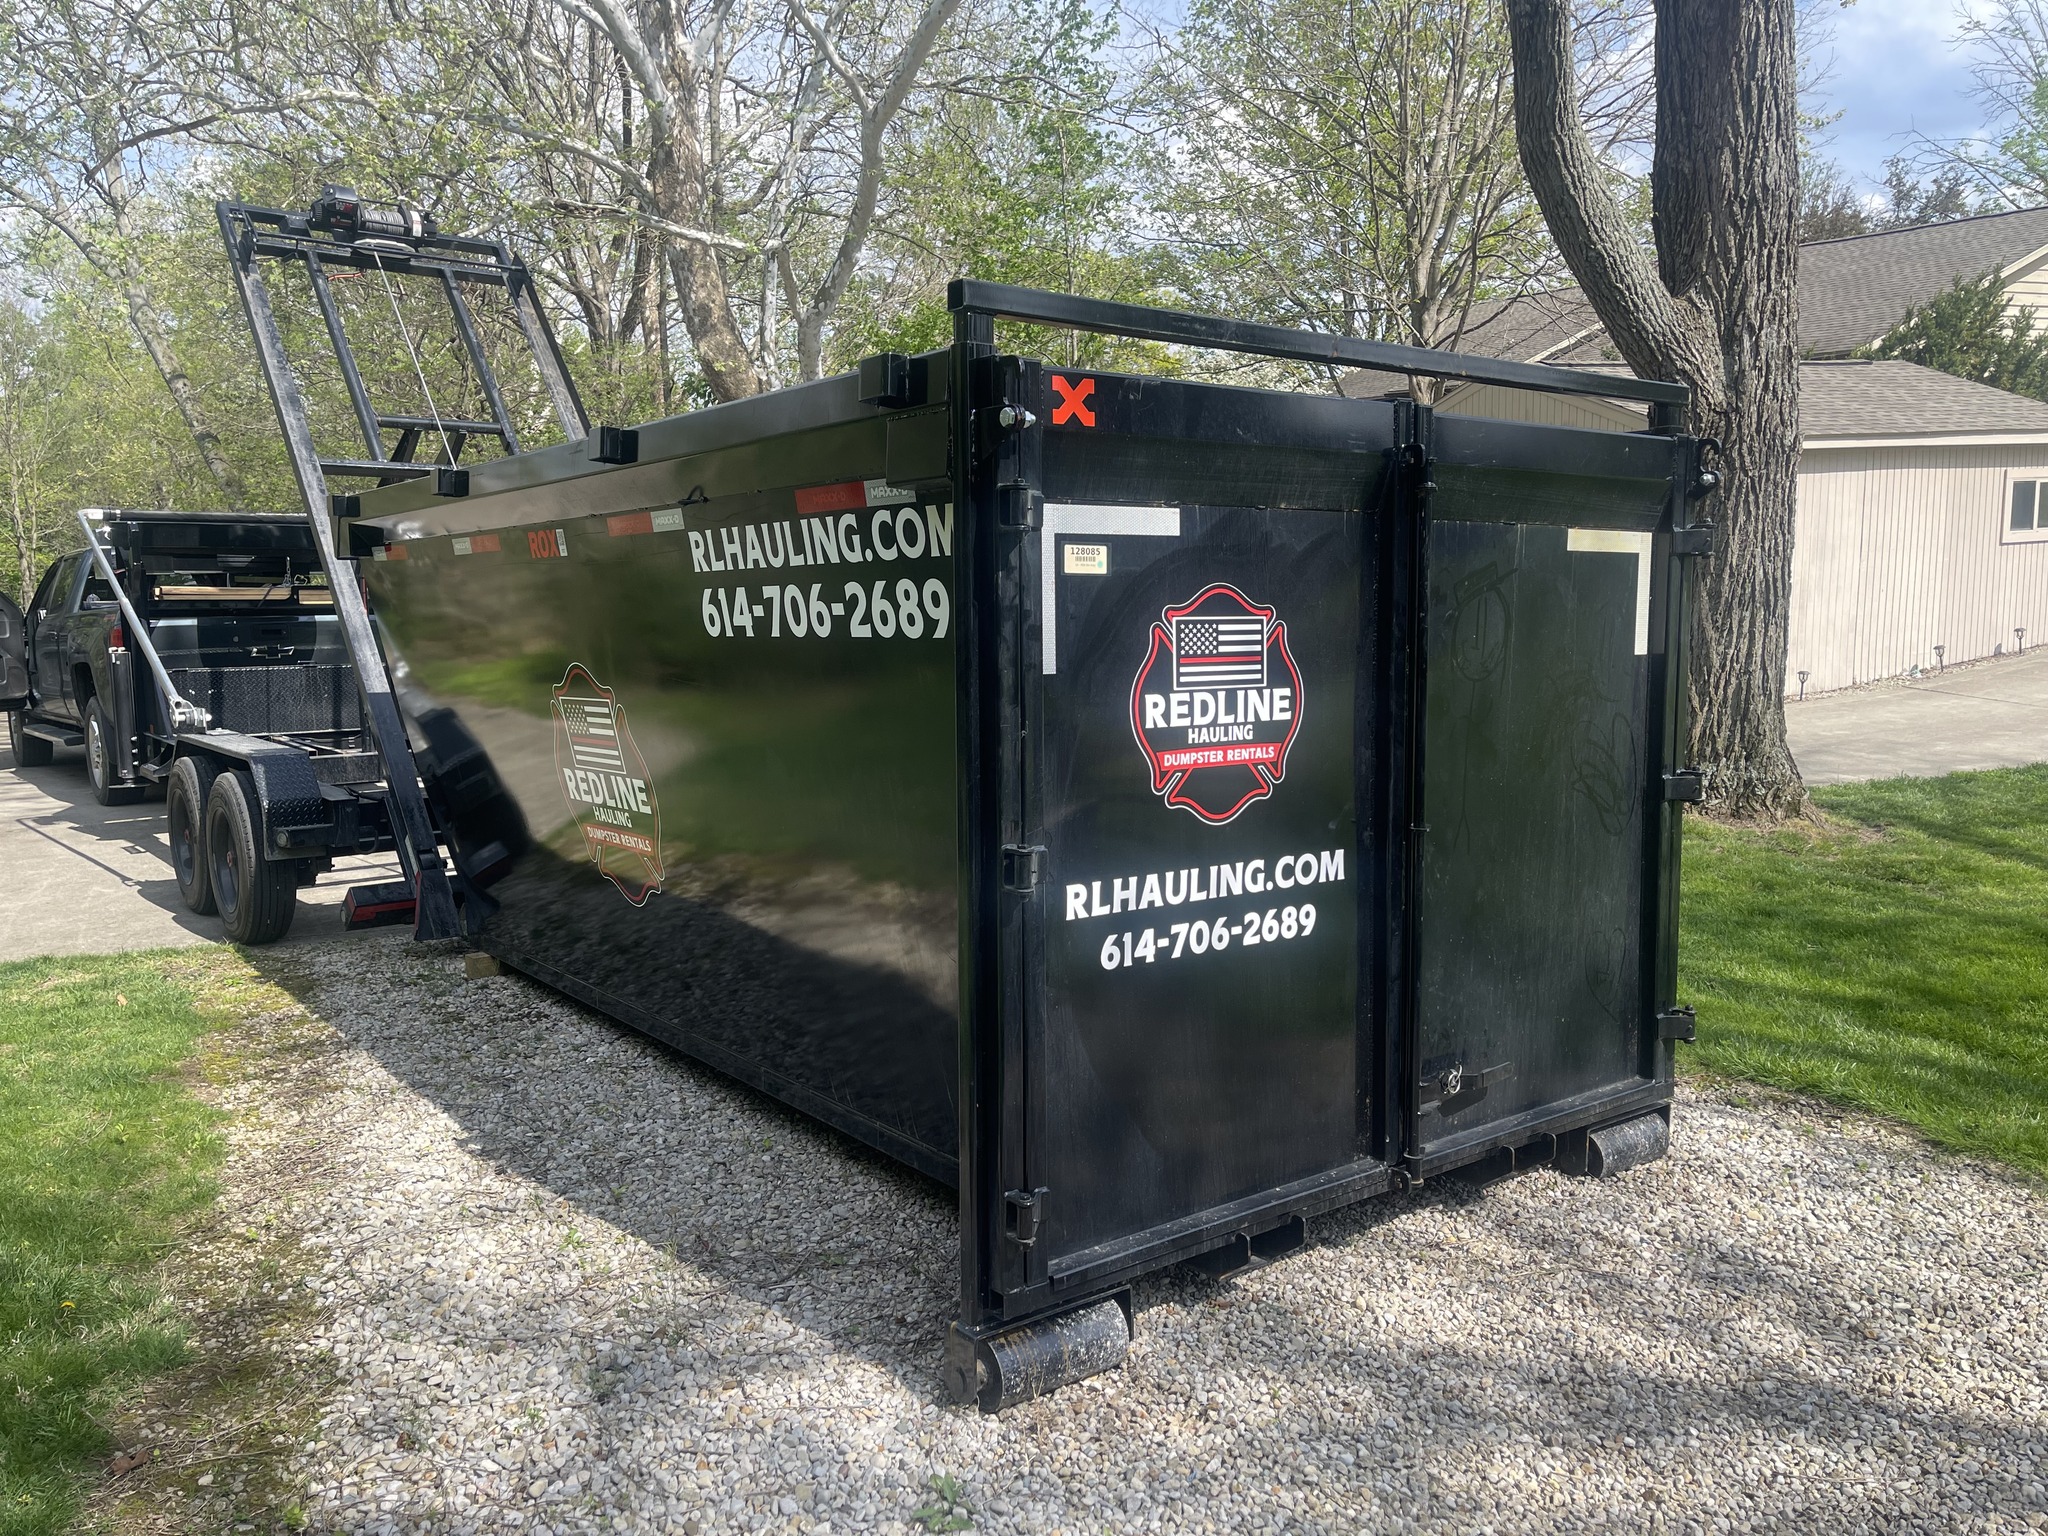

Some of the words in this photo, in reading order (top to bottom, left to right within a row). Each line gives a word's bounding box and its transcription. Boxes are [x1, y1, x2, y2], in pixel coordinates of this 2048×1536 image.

[527, 529, 560, 558] ROX
[687, 503, 954, 573] RLHAULING.COM
[1070, 547, 1101, 556] 128085
[702, 578, 950, 639] 614-706-2689
[1145, 688, 1292, 728] REDLINE
[1188, 725, 1253, 744] HAULING
[1164, 750, 1223, 767] DUMPSTER
[1227, 746, 1275, 762] RENTALS
[562, 768, 652, 815] REDLINE
[592, 805, 633, 828] HAULING
[586, 826, 621, 845] DUMPSTER
[620, 834, 652, 852] RENTALS
[1065, 848, 1346, 921] RLHAULING.COM
[1100, 903, 1317, 971] 614-706-2689
